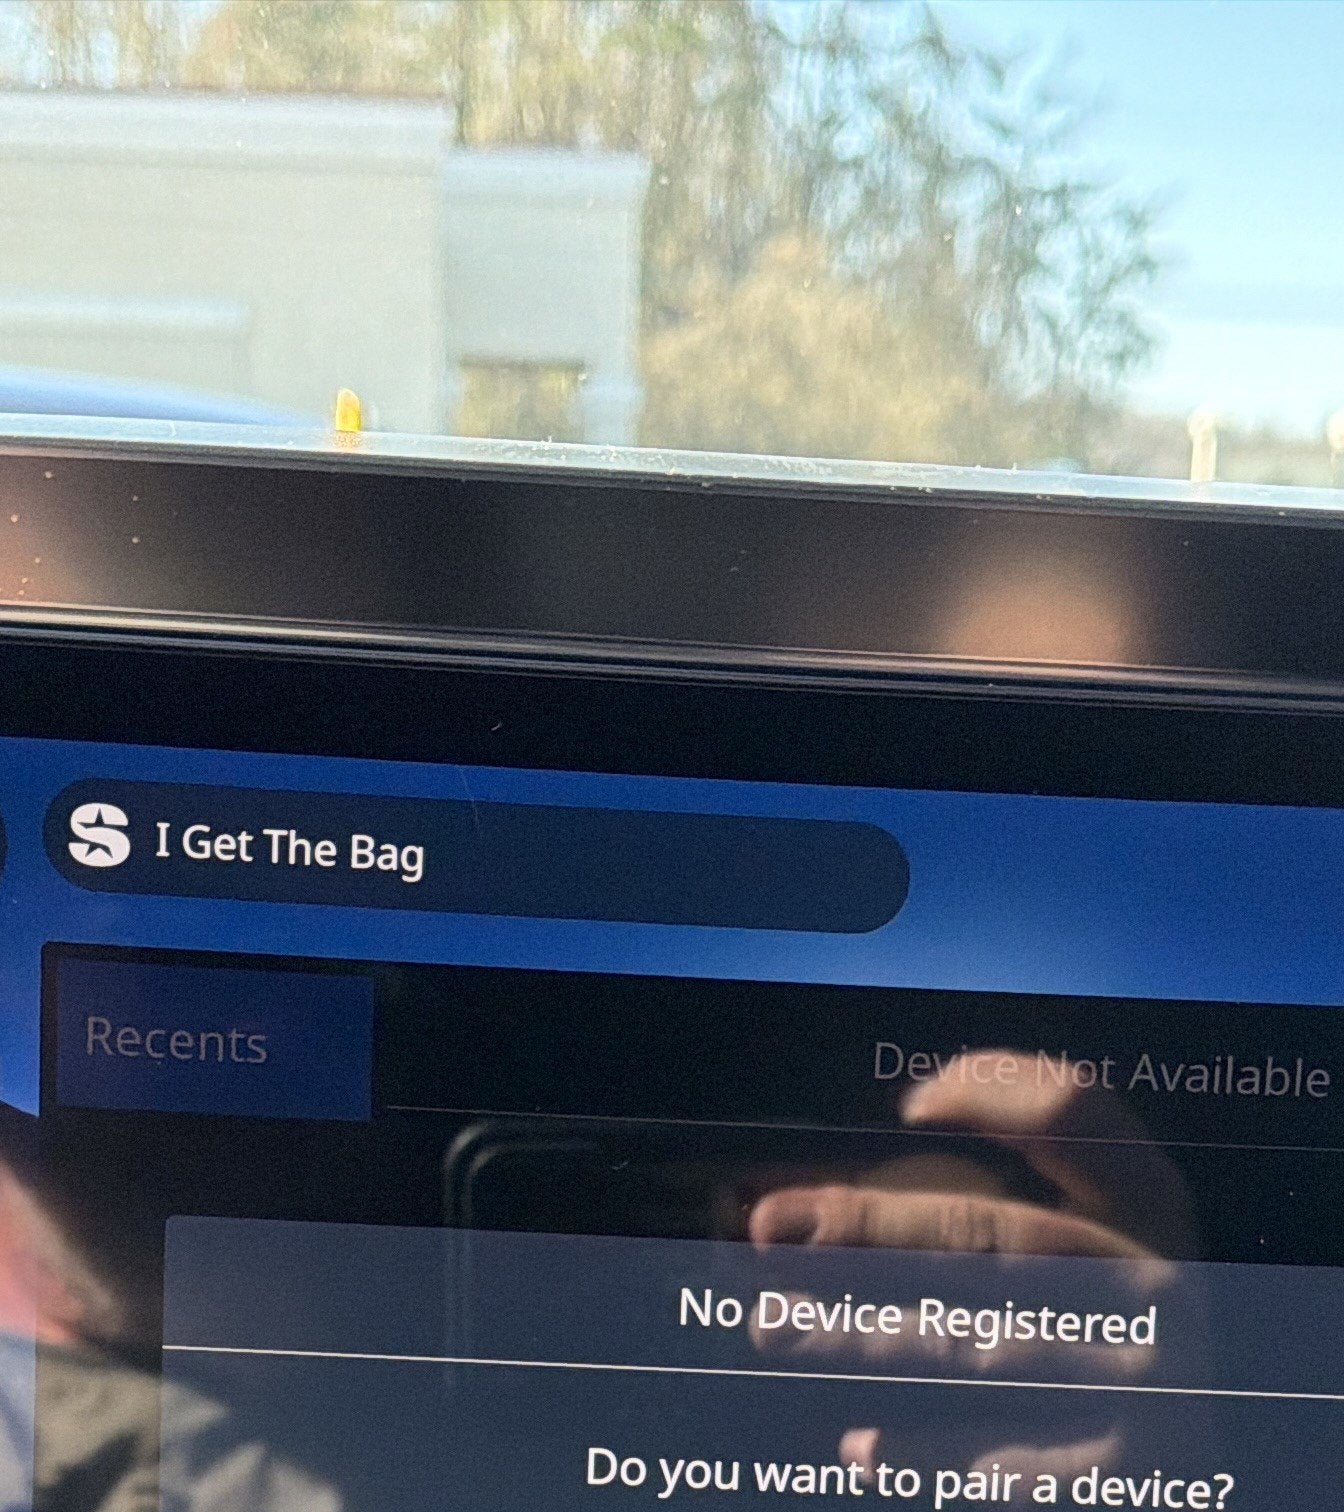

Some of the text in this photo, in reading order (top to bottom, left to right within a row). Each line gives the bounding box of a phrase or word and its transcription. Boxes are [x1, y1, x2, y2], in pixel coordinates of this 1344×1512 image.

[155, 822, 171, 858] I
[182, 824, 255, 863] Get
[262, 828, 338, 868] The
[350, 834, 425, 883] Bag
[85, 1014, 268, 1065] Recents
[873, 1041, 1331, 1098] Device Not Available
[679, 1287, 1158, 1351] No Device Registered
[586, 1447, 1235, 1511] Do you want to pair a device?
